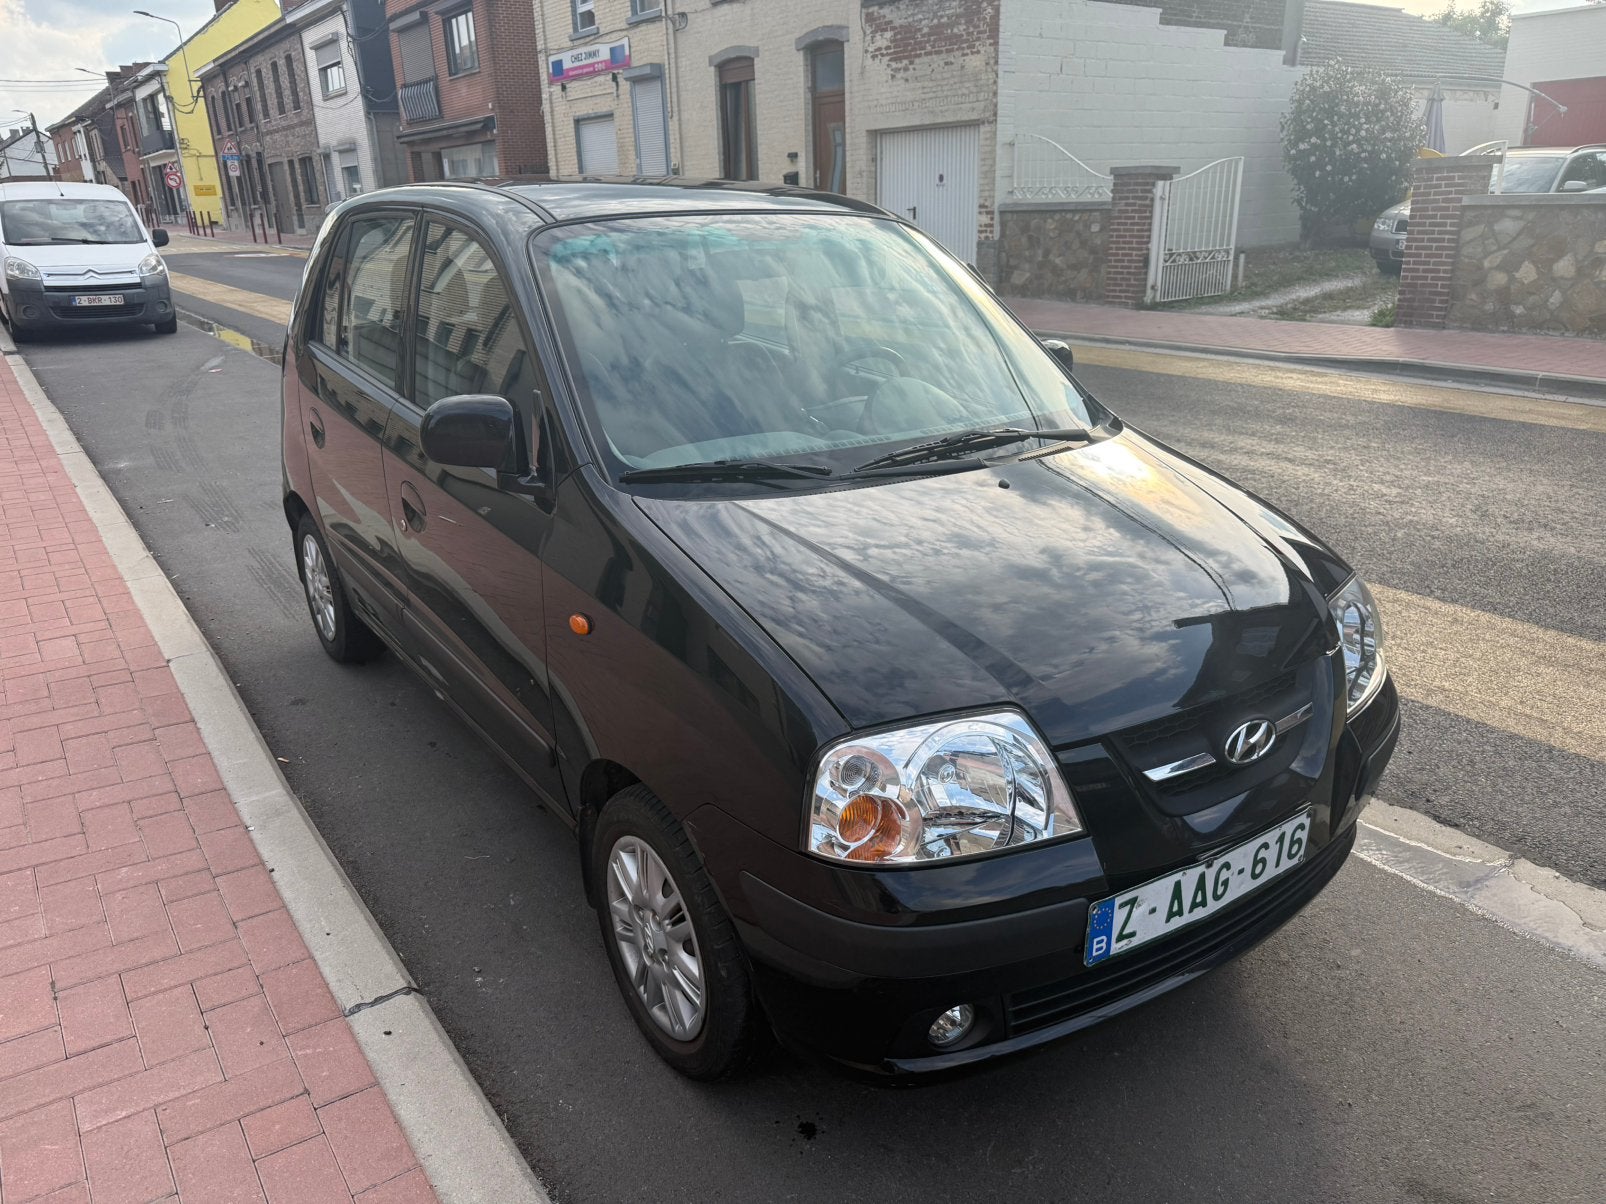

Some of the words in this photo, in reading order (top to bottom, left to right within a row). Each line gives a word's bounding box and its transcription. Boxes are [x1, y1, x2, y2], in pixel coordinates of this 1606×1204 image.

[570, 52, 583, 64] CHEZ
[584, 48, 600, 61] JIMMY
[1115, 822, 1306, 944] Z-AAG-616
[1092, 935, 1107, 957] B
